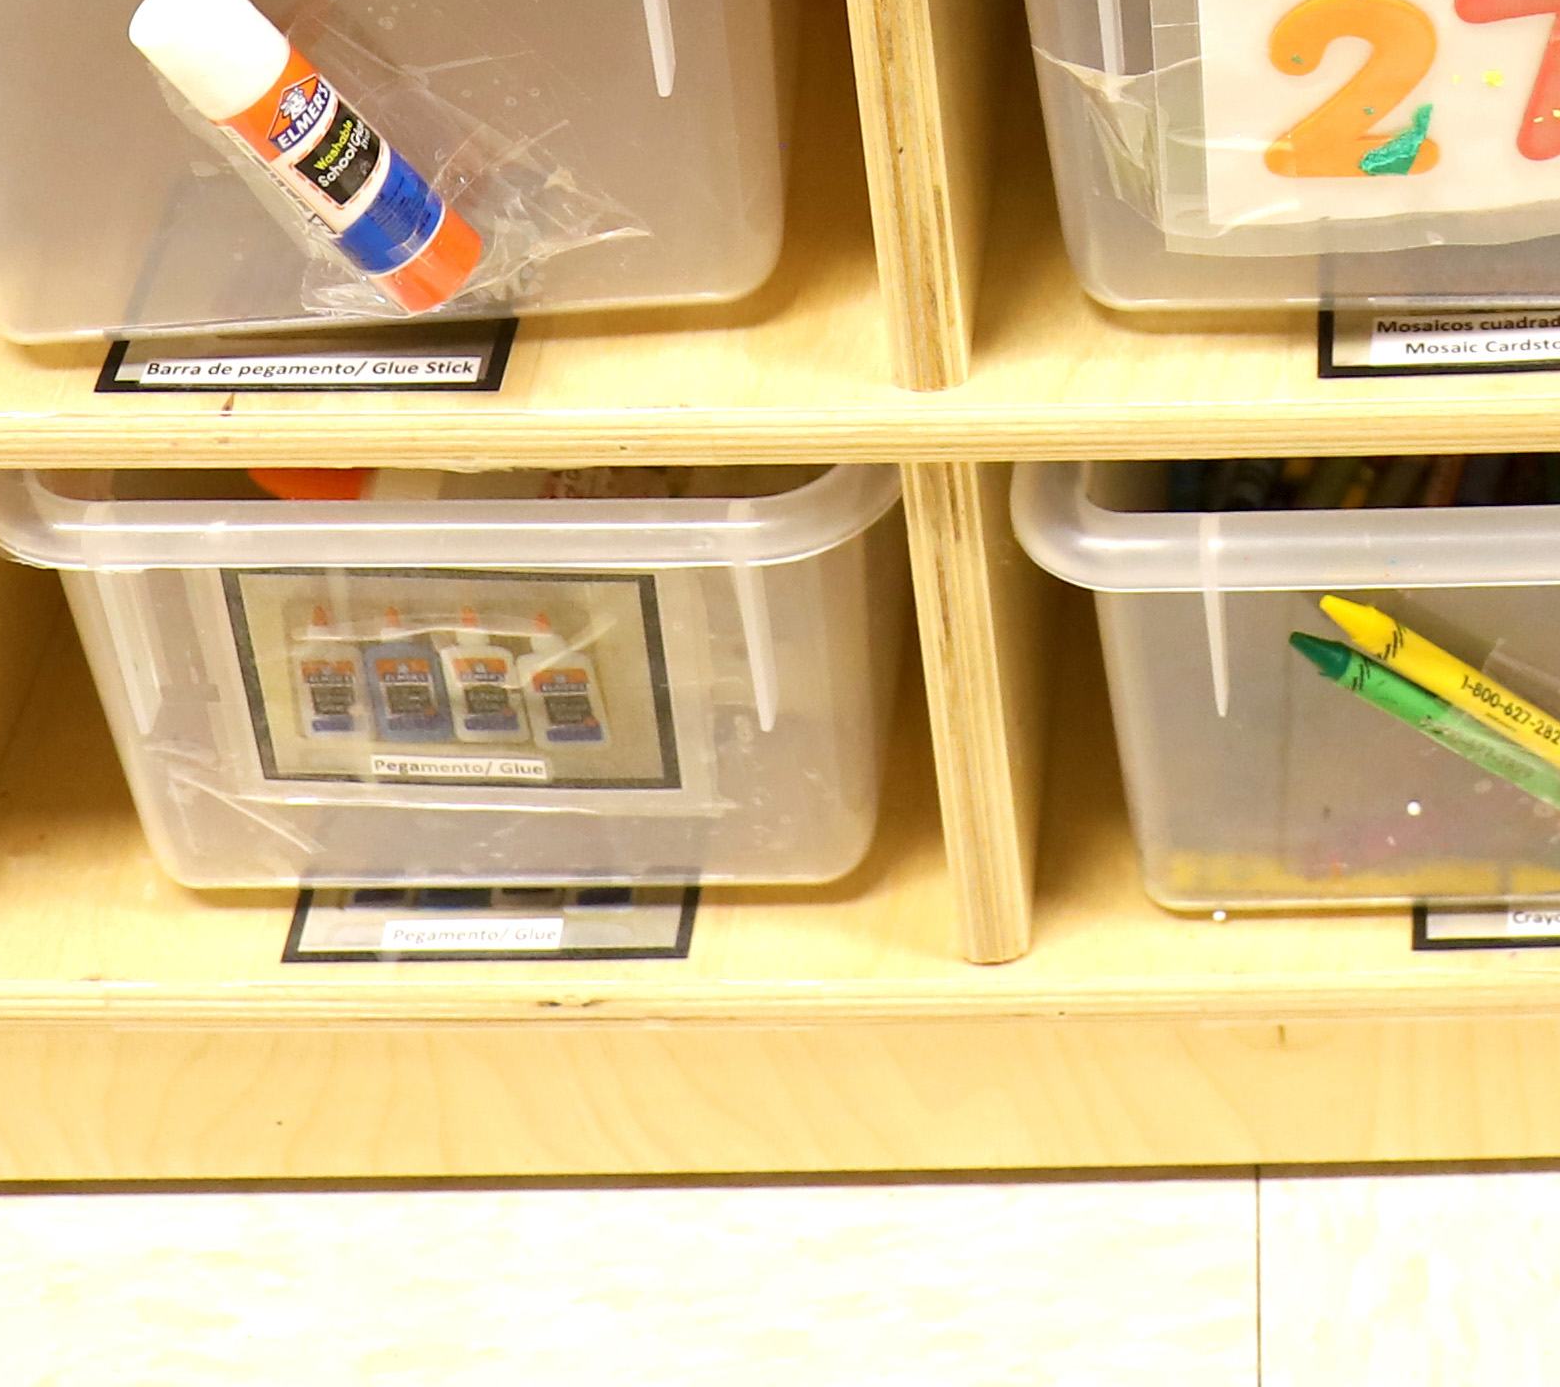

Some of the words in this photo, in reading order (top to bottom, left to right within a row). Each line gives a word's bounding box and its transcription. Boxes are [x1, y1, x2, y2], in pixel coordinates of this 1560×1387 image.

[277, 82, 331, 151] ELMER'S
[313, 119, 354, 171] Washable
[317, 141, 359, 188] School
[1377, 320, 1473, 332] Mosaicos
[1406, 341, 1478, 354] Mosaic
[146, 362, 201, 375] Barra
[208, 362, 232, 375] de
[238, 360, 368, 377] pegamento/
[372, 361, 418, 374] Glue
[425, 360, 473, 373] Stick
[374, 759, 493, 775] Pegamento/
[500, 761, 543, 775] Glue
[393, 927, 509, 944] Pegamento/
[515, 928, 557, 941] Glue
